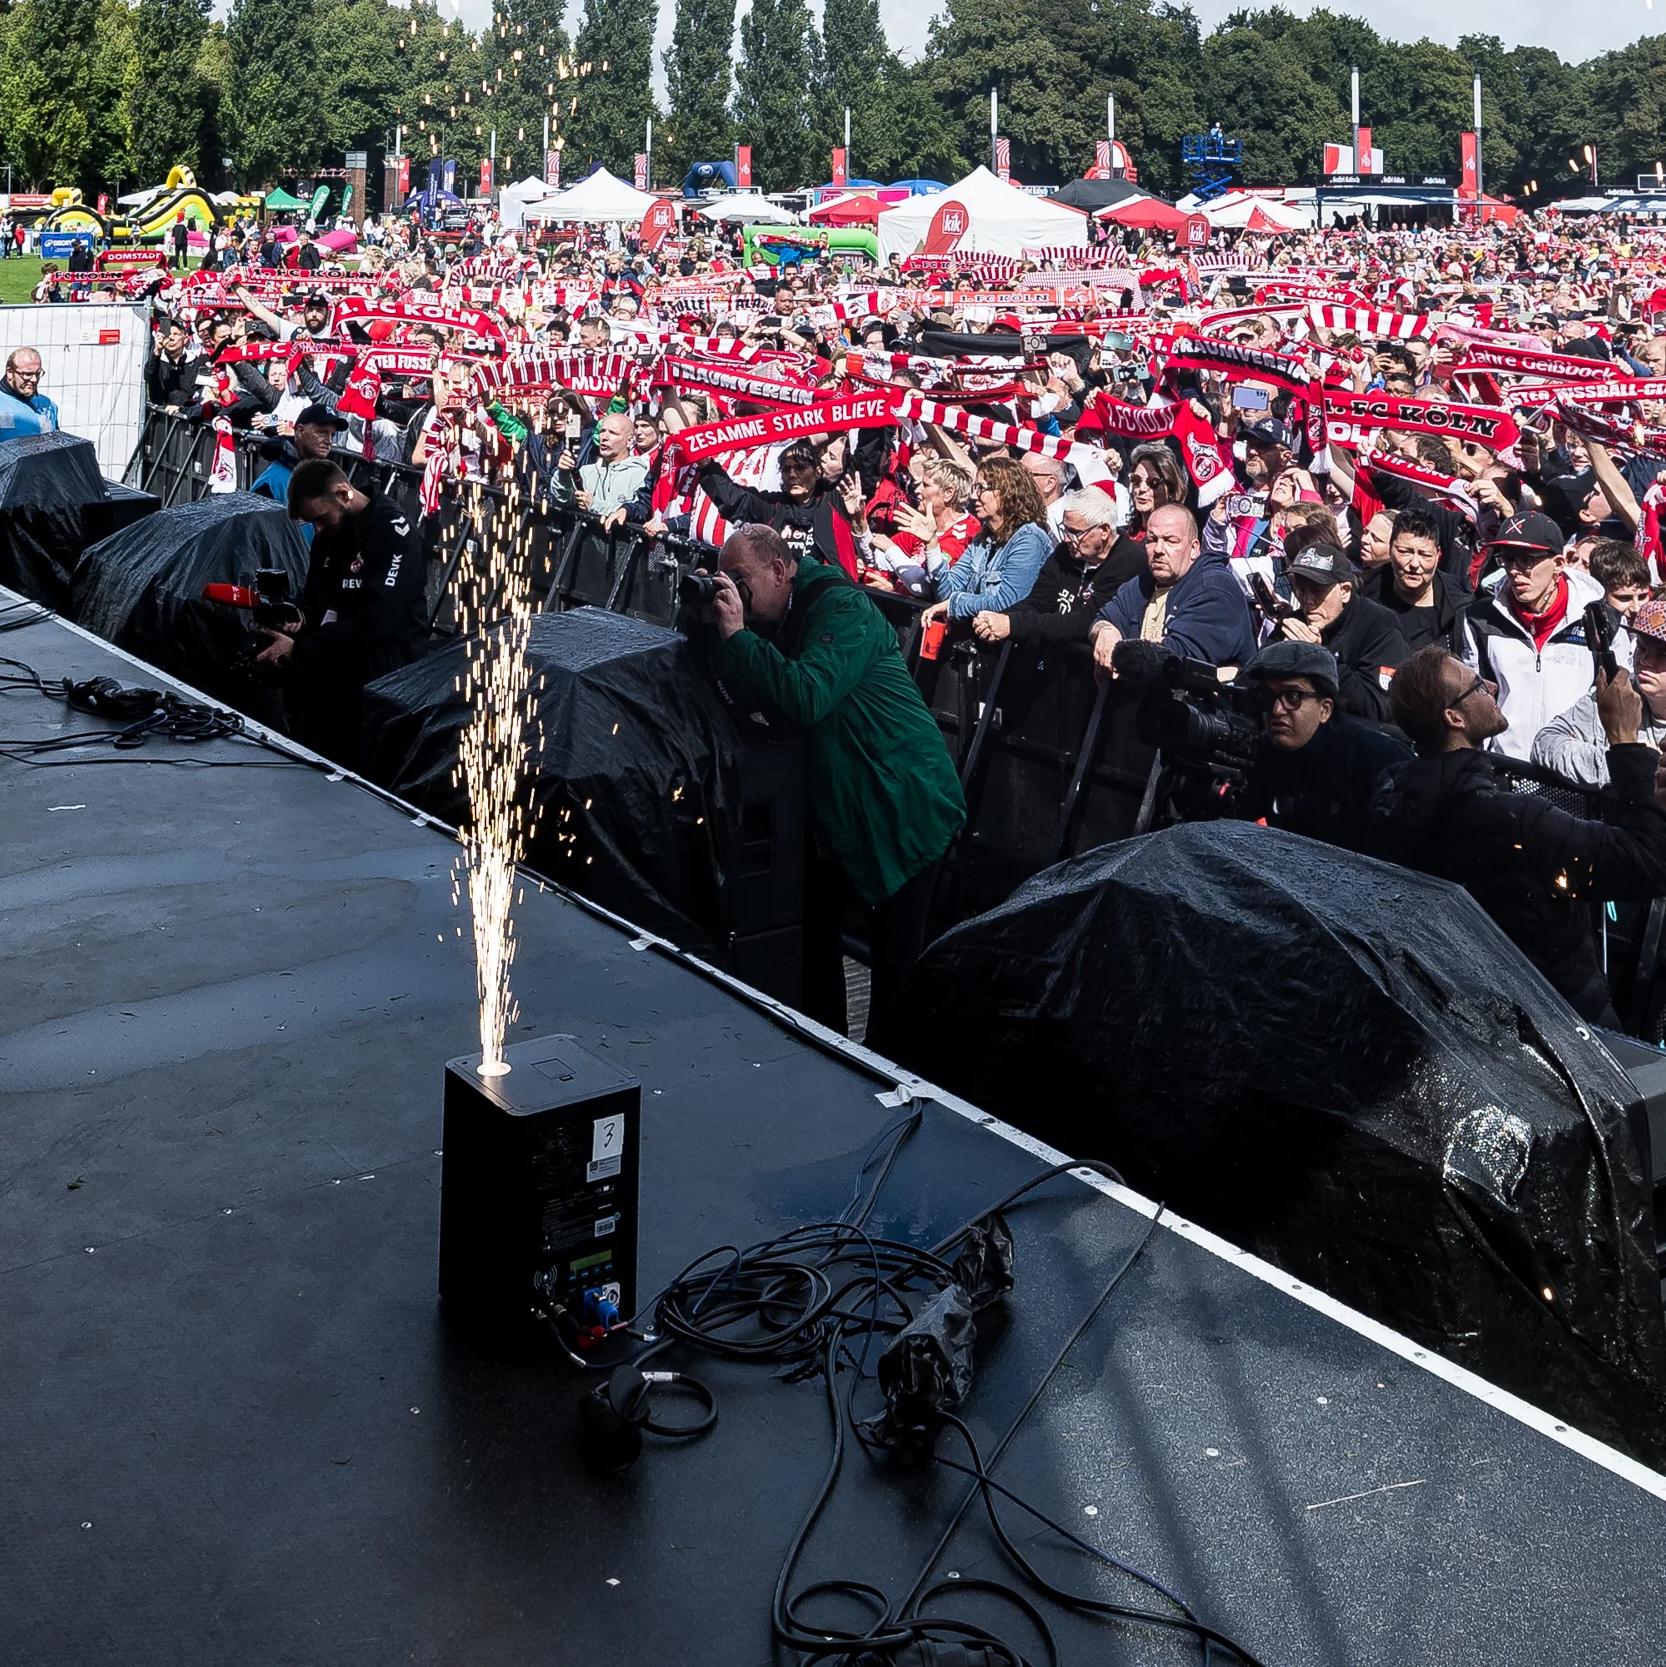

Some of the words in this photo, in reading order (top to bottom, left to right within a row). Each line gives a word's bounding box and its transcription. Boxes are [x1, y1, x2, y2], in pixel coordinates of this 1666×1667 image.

[107, 252, 162, 262] DOMSTADT
[277, 268, 302, 278] FC
[309, 266, 376, 280] KÖLN
[1289, 288, 1304, 297] FC
[340, 301, 359, 315] 1.
[364, 301, 396, 314] FC
[404, 304, 481, 327] KÖLN
[240, 344, 255, 357] 1.
[259, 343, 286, 355] FC
[1470, 349, 1517, 367] Jahre
[1521, 356, 1618, 382] Geißbock
[671, 363, 816, 406] TRAUMVEREIN
[684, 418, 767, 453] ZESAMME
[772, 407, 825, 433] STARK
[831, 398, 886, 423] BLIEVE
[1351, 401, 1389, 419] FC
[1398, 404, 1501, 439] KÖLN
[603, 1120, 617, 1150] 3
